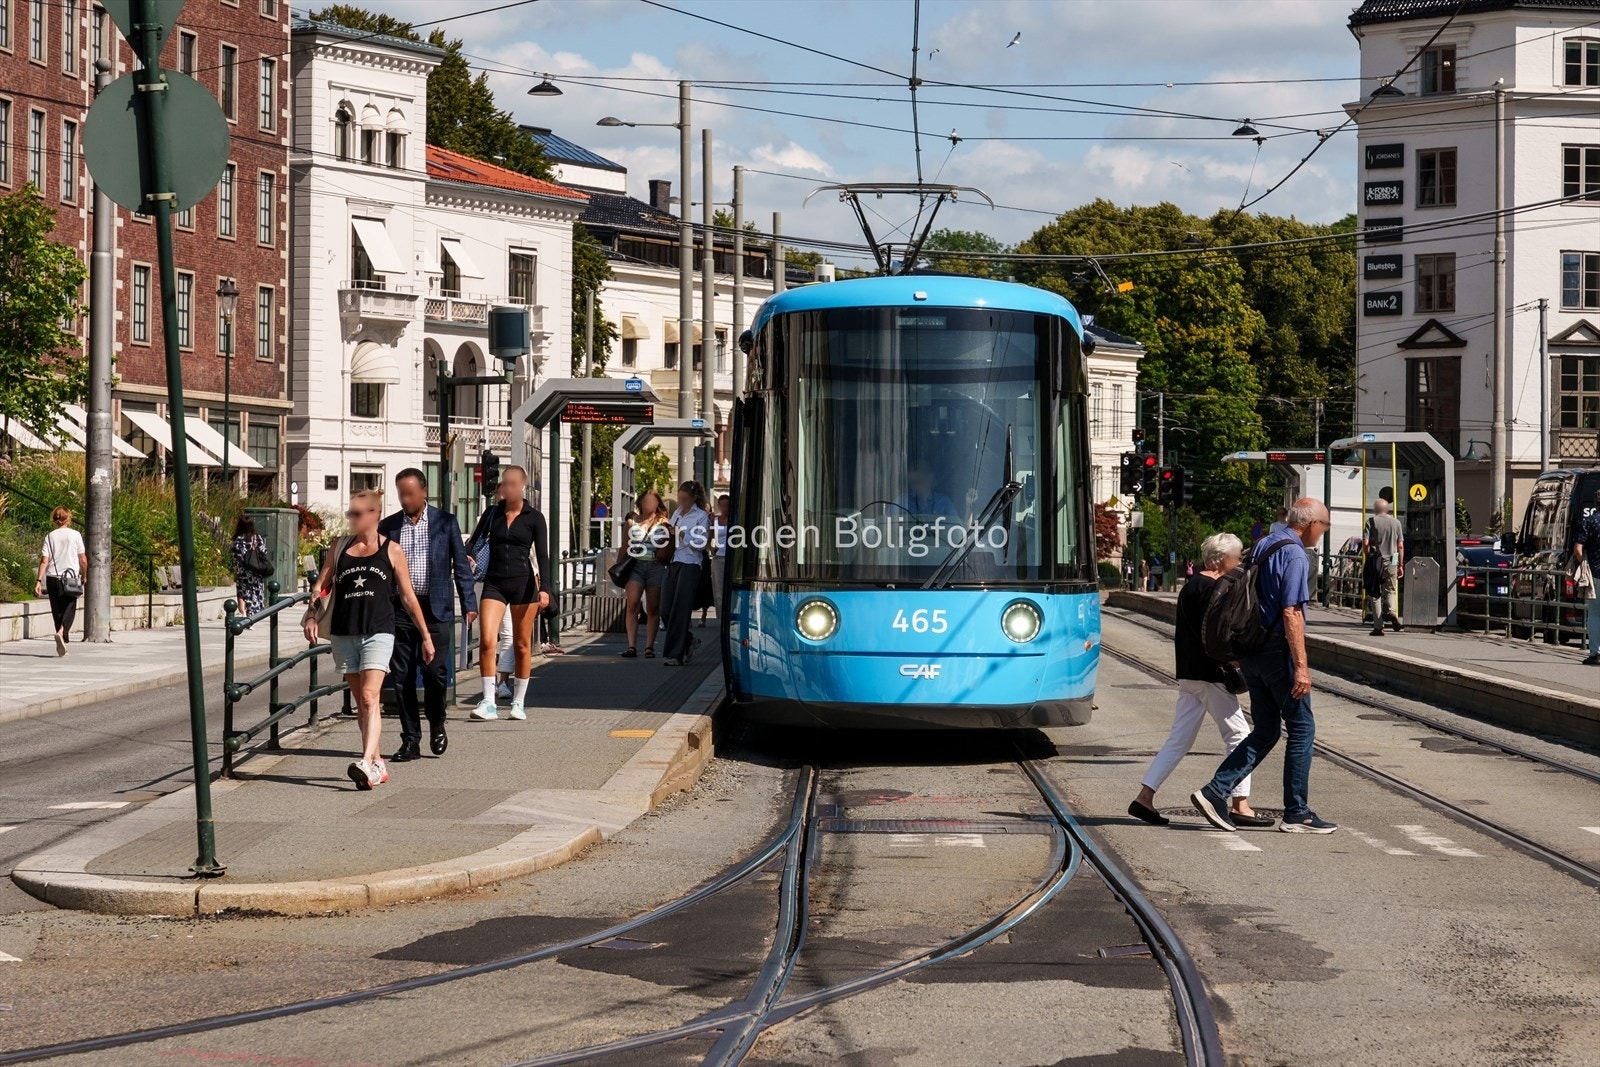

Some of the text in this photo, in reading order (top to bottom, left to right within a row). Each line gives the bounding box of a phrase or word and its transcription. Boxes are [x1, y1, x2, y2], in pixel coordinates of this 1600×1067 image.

[1123, 456, 1130, 466] S
[1414, 487, 1423, 498] A
[369, 566, 387, 580] ROAD
[892, 608, 948, 634] 465
[899, 664, 942, 679] CAF
